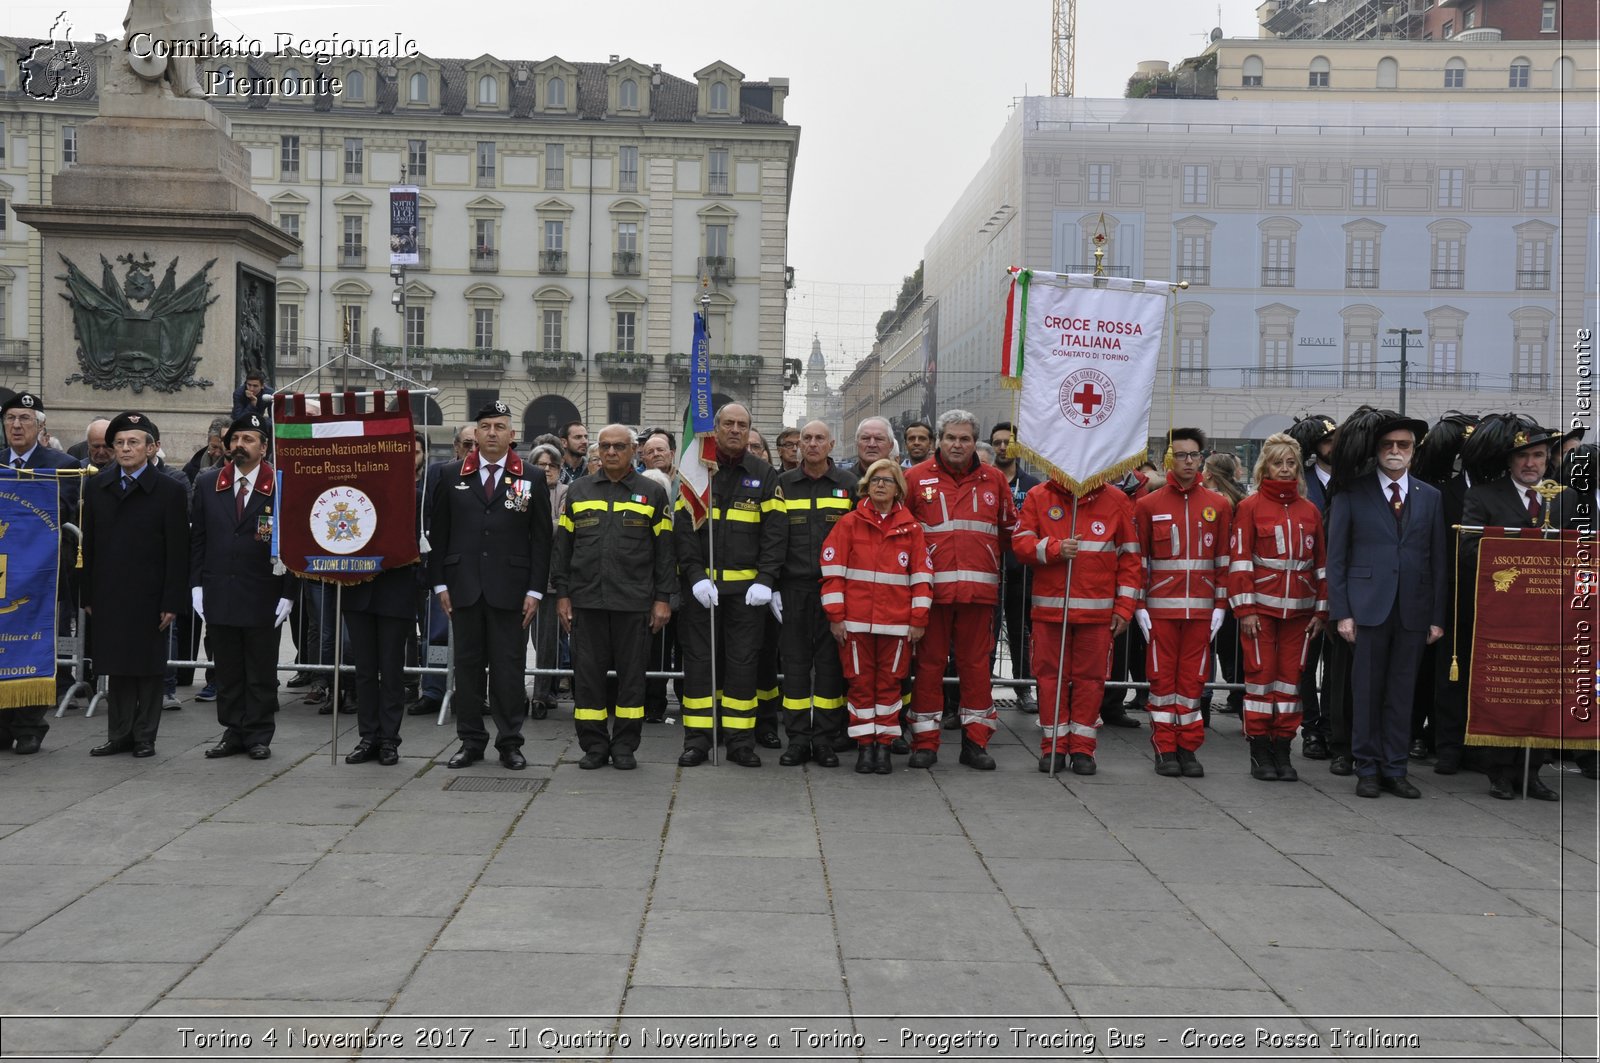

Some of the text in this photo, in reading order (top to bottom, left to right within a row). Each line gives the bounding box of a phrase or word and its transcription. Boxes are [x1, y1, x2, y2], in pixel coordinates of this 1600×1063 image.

[1044, 315, 1143, 336] CROCE ROSSA
[1061, 334, 1121, 350] ITALIANA
[1300, 337, 1423, 346] REALE MUUA
[1052, 349, 1130, 362] COMITATO DI TORINO
[332, 443, 377, 455] Nazionale
[378, 441, 411, 453] Militari
[294, 461, 390, 475] Croce Rossa Italiana
[312, 560, 376, 570] SEZIONE DI TORINO
[1492, 556, 1551, 565] ASSOCIAZIONE
[31, 632, 42, 640] di
